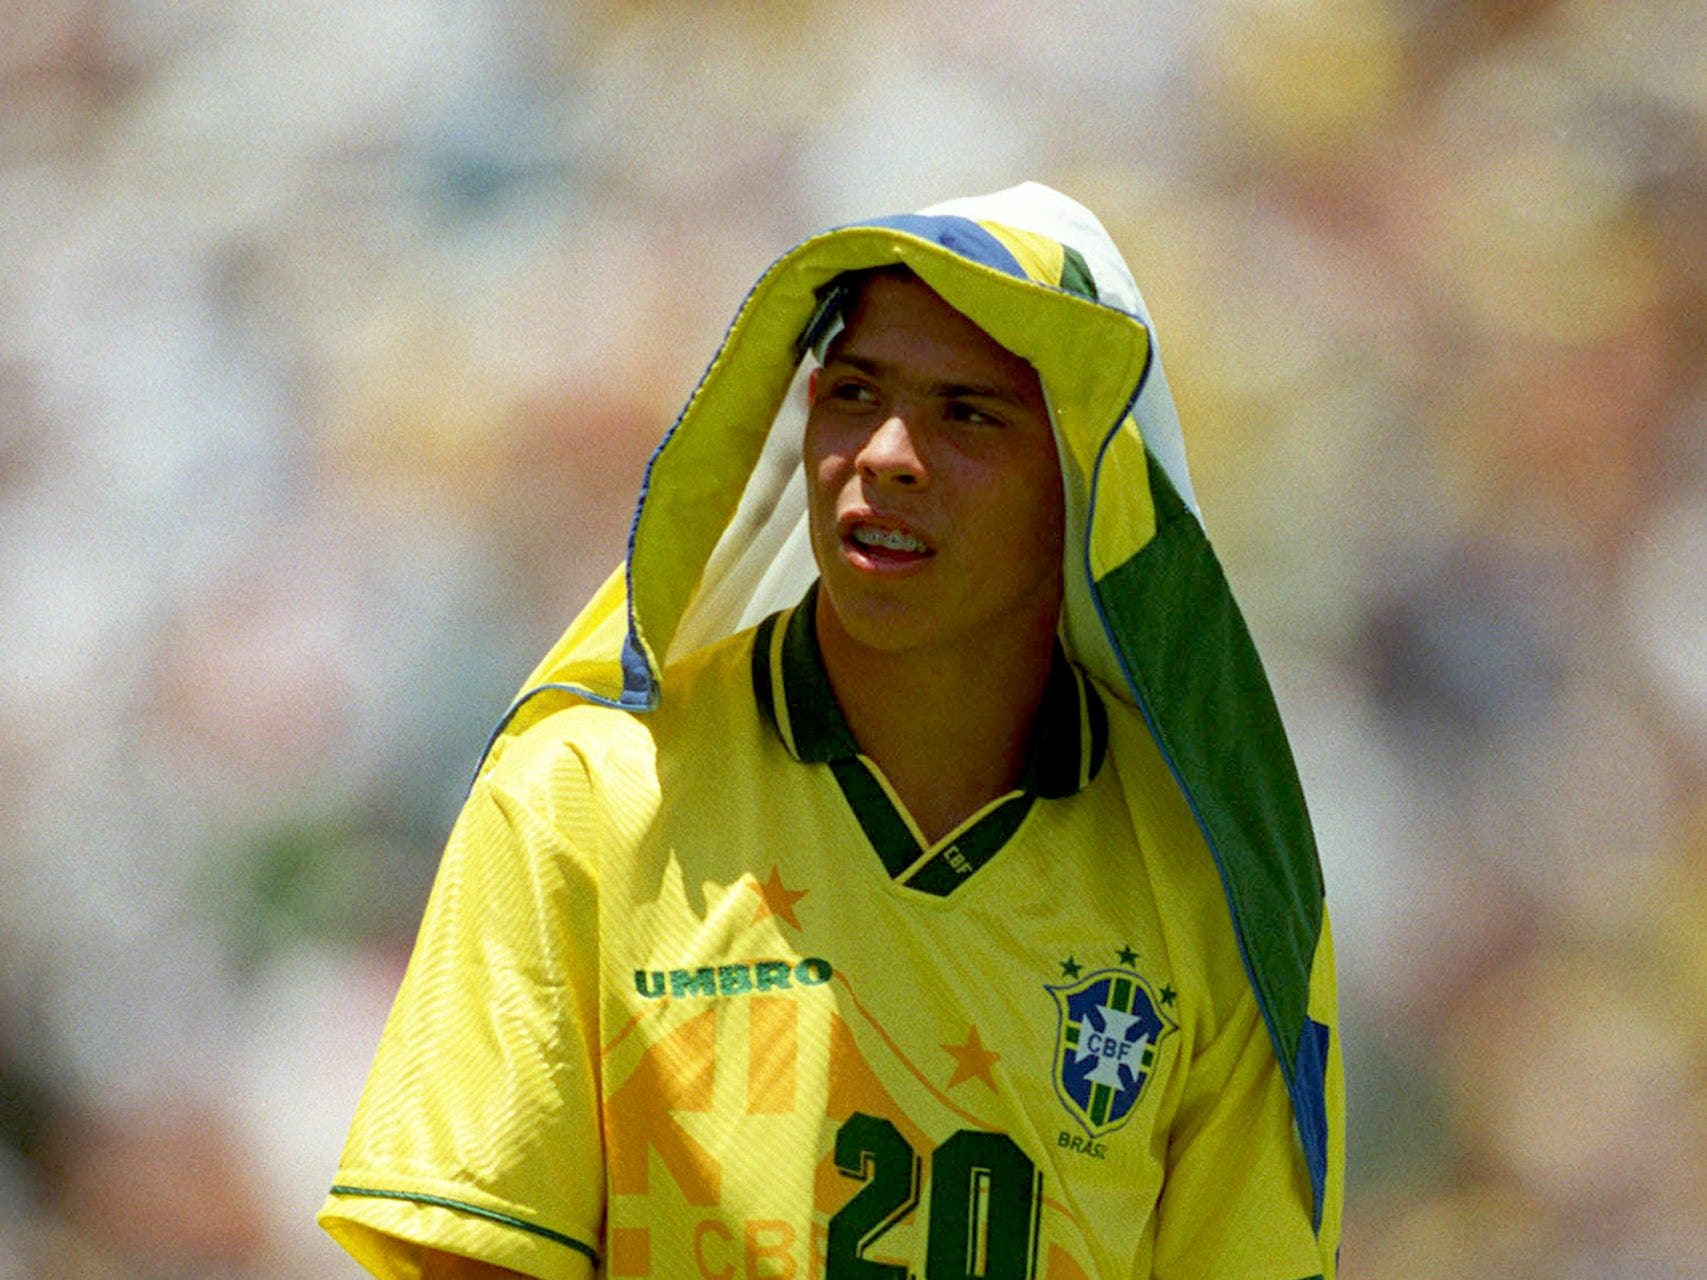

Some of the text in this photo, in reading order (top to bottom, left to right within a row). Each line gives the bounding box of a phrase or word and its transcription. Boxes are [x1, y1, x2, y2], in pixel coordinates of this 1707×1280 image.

[943, 845, 973, 874] CBF
[634, 956, 834, 999] UMBRO
[1086, 1033, 1133, 1061] CBF
